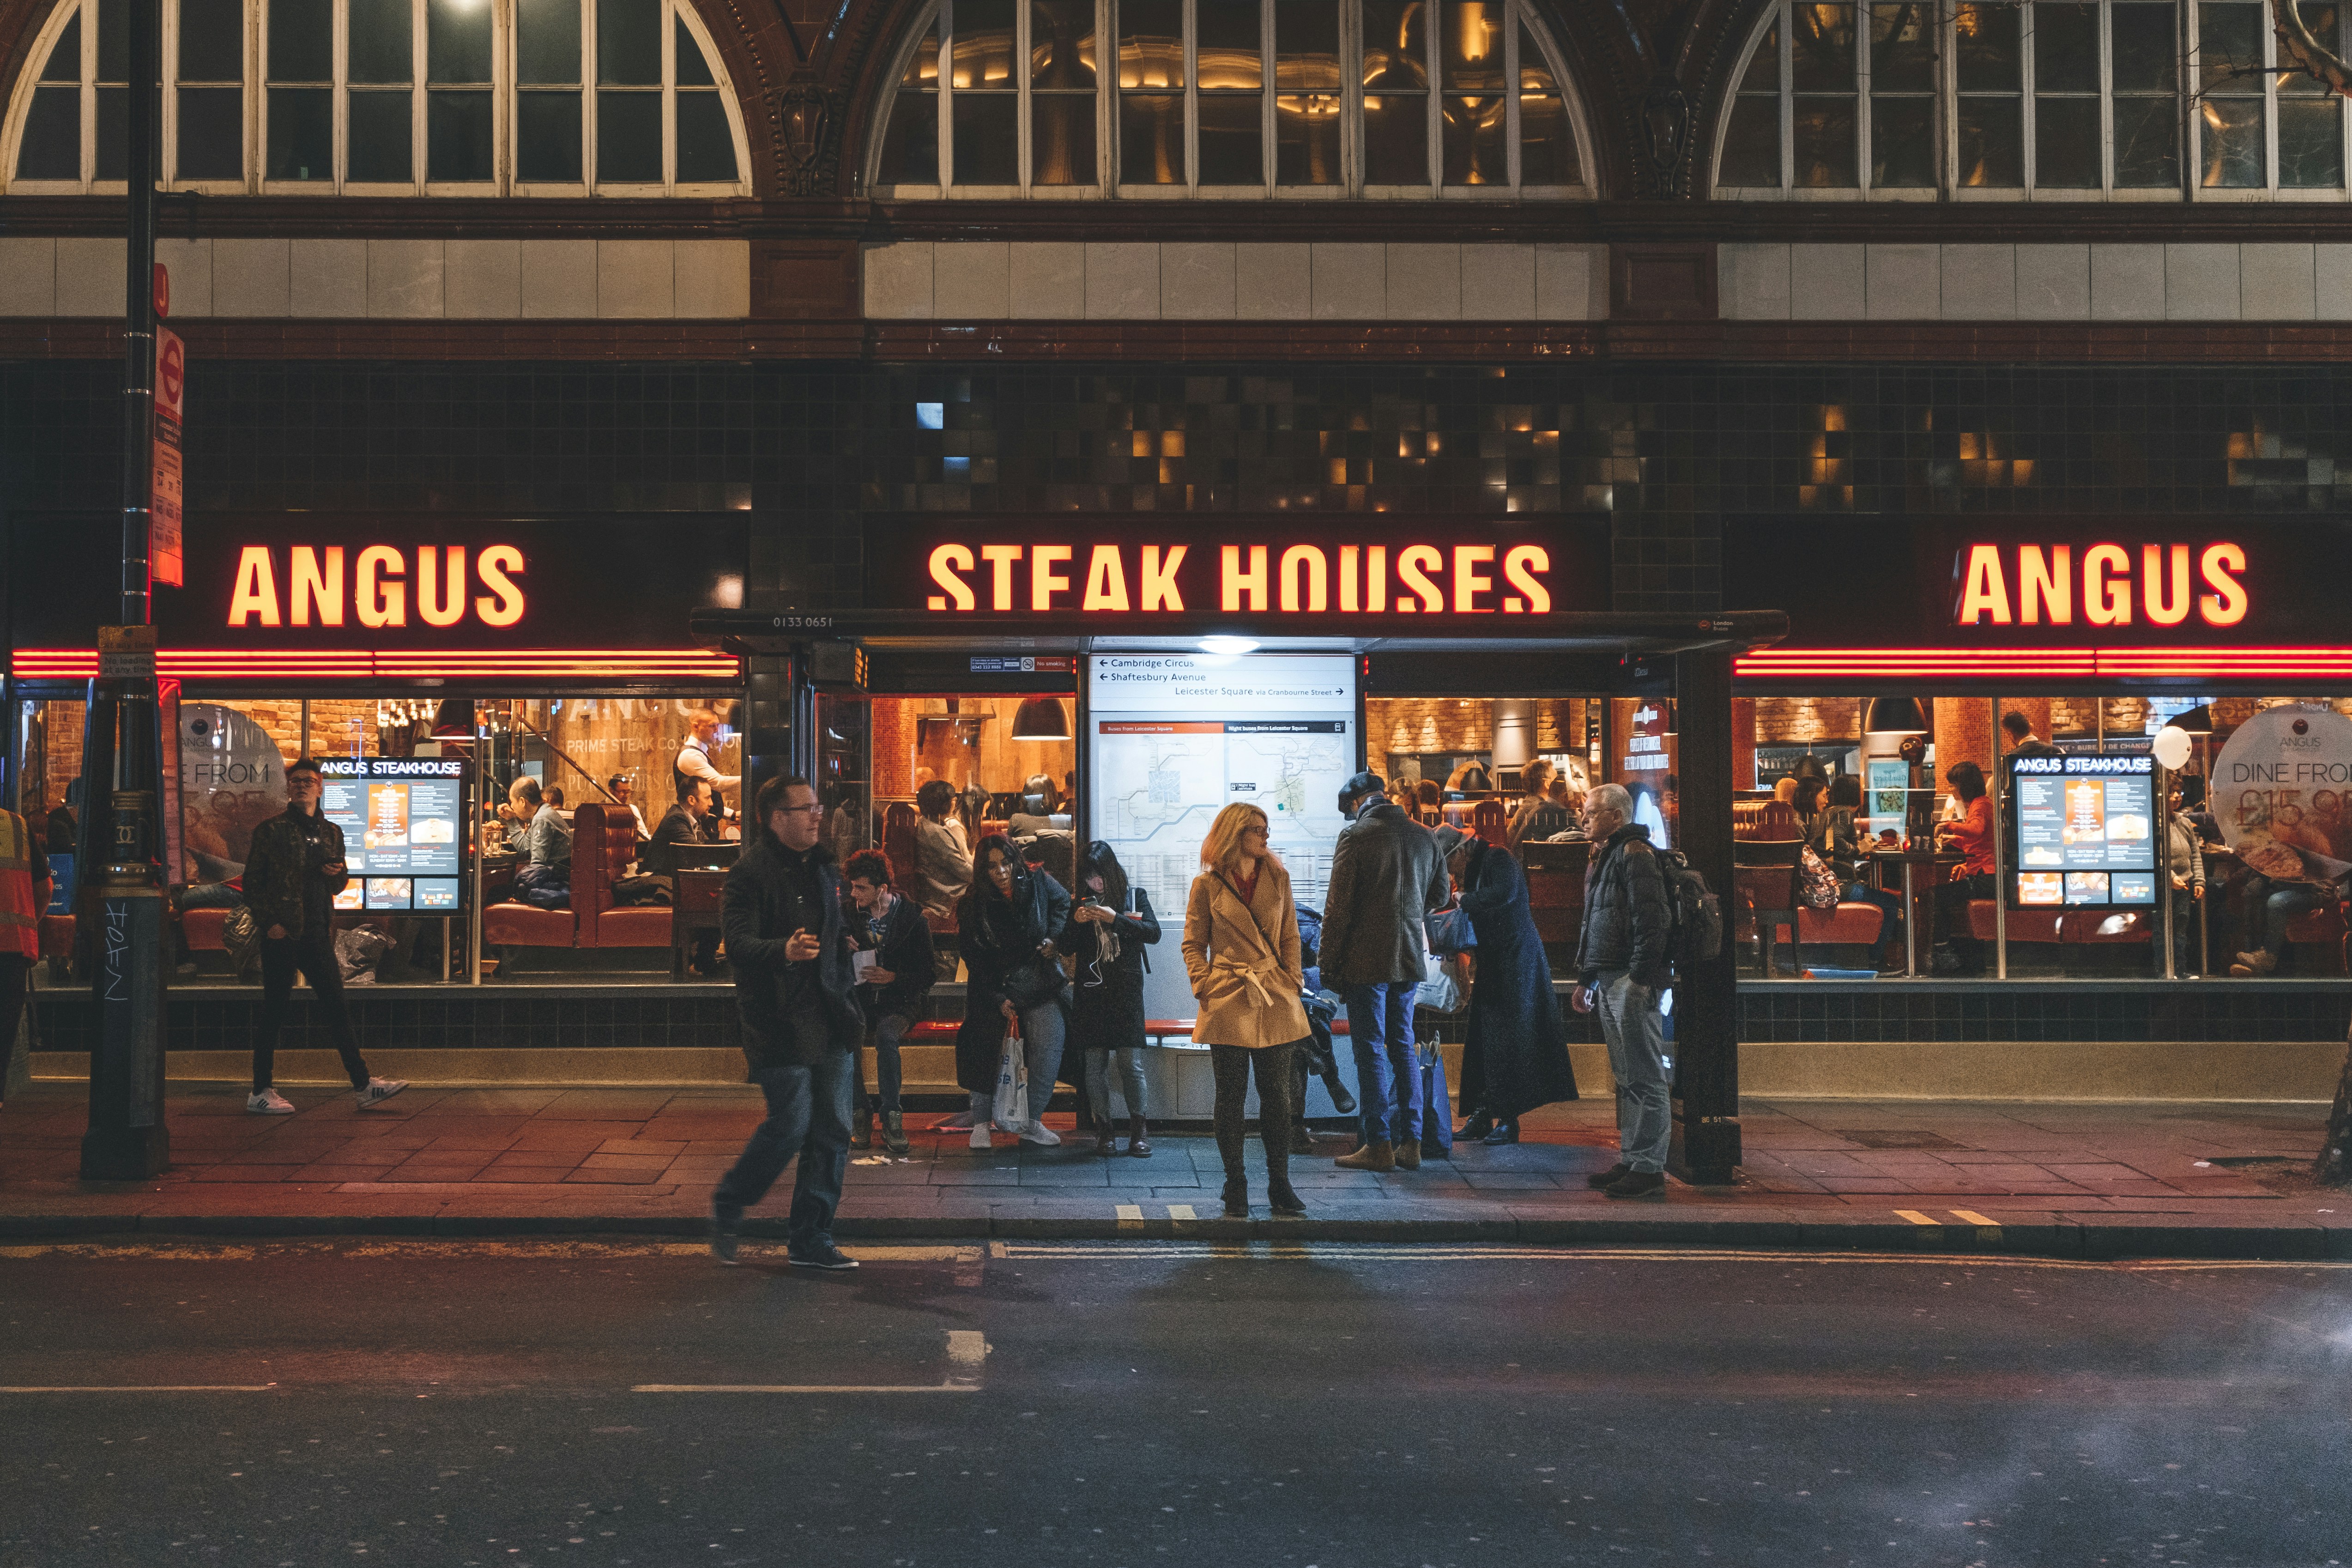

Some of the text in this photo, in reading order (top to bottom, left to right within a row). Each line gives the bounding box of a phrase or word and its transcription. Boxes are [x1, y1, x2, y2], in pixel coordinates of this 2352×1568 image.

[159, 273, 166, 307] J
[927, 544, 1551, 613] STEAK HOUSES
[227, 545, 525, 627] ANGUS
[1960, 544, 2248, 627] ANGUS
[774, 617, 832, 627] 0133 0651
[120, 656, 151, 665] loading
[1111, 659, 1162, 669] Cambridge
[1111, 673, 1168, 683] Shaftesbury
[1221, 687, 1253, 696] Square
[567, 739, 608, 753] PRIME
[612, 738, 654, 752] STEAK
[2279, 737, 2321, 747] ANGUS
[320, 762, 461, 774] ANGUS STEAKHOUSE
[2014, 758, 2152, 771] ANGUS STEAKHOUSE
[195, 763, 269, 783] FROM
[2233, 763, 2289, 782] DINE
